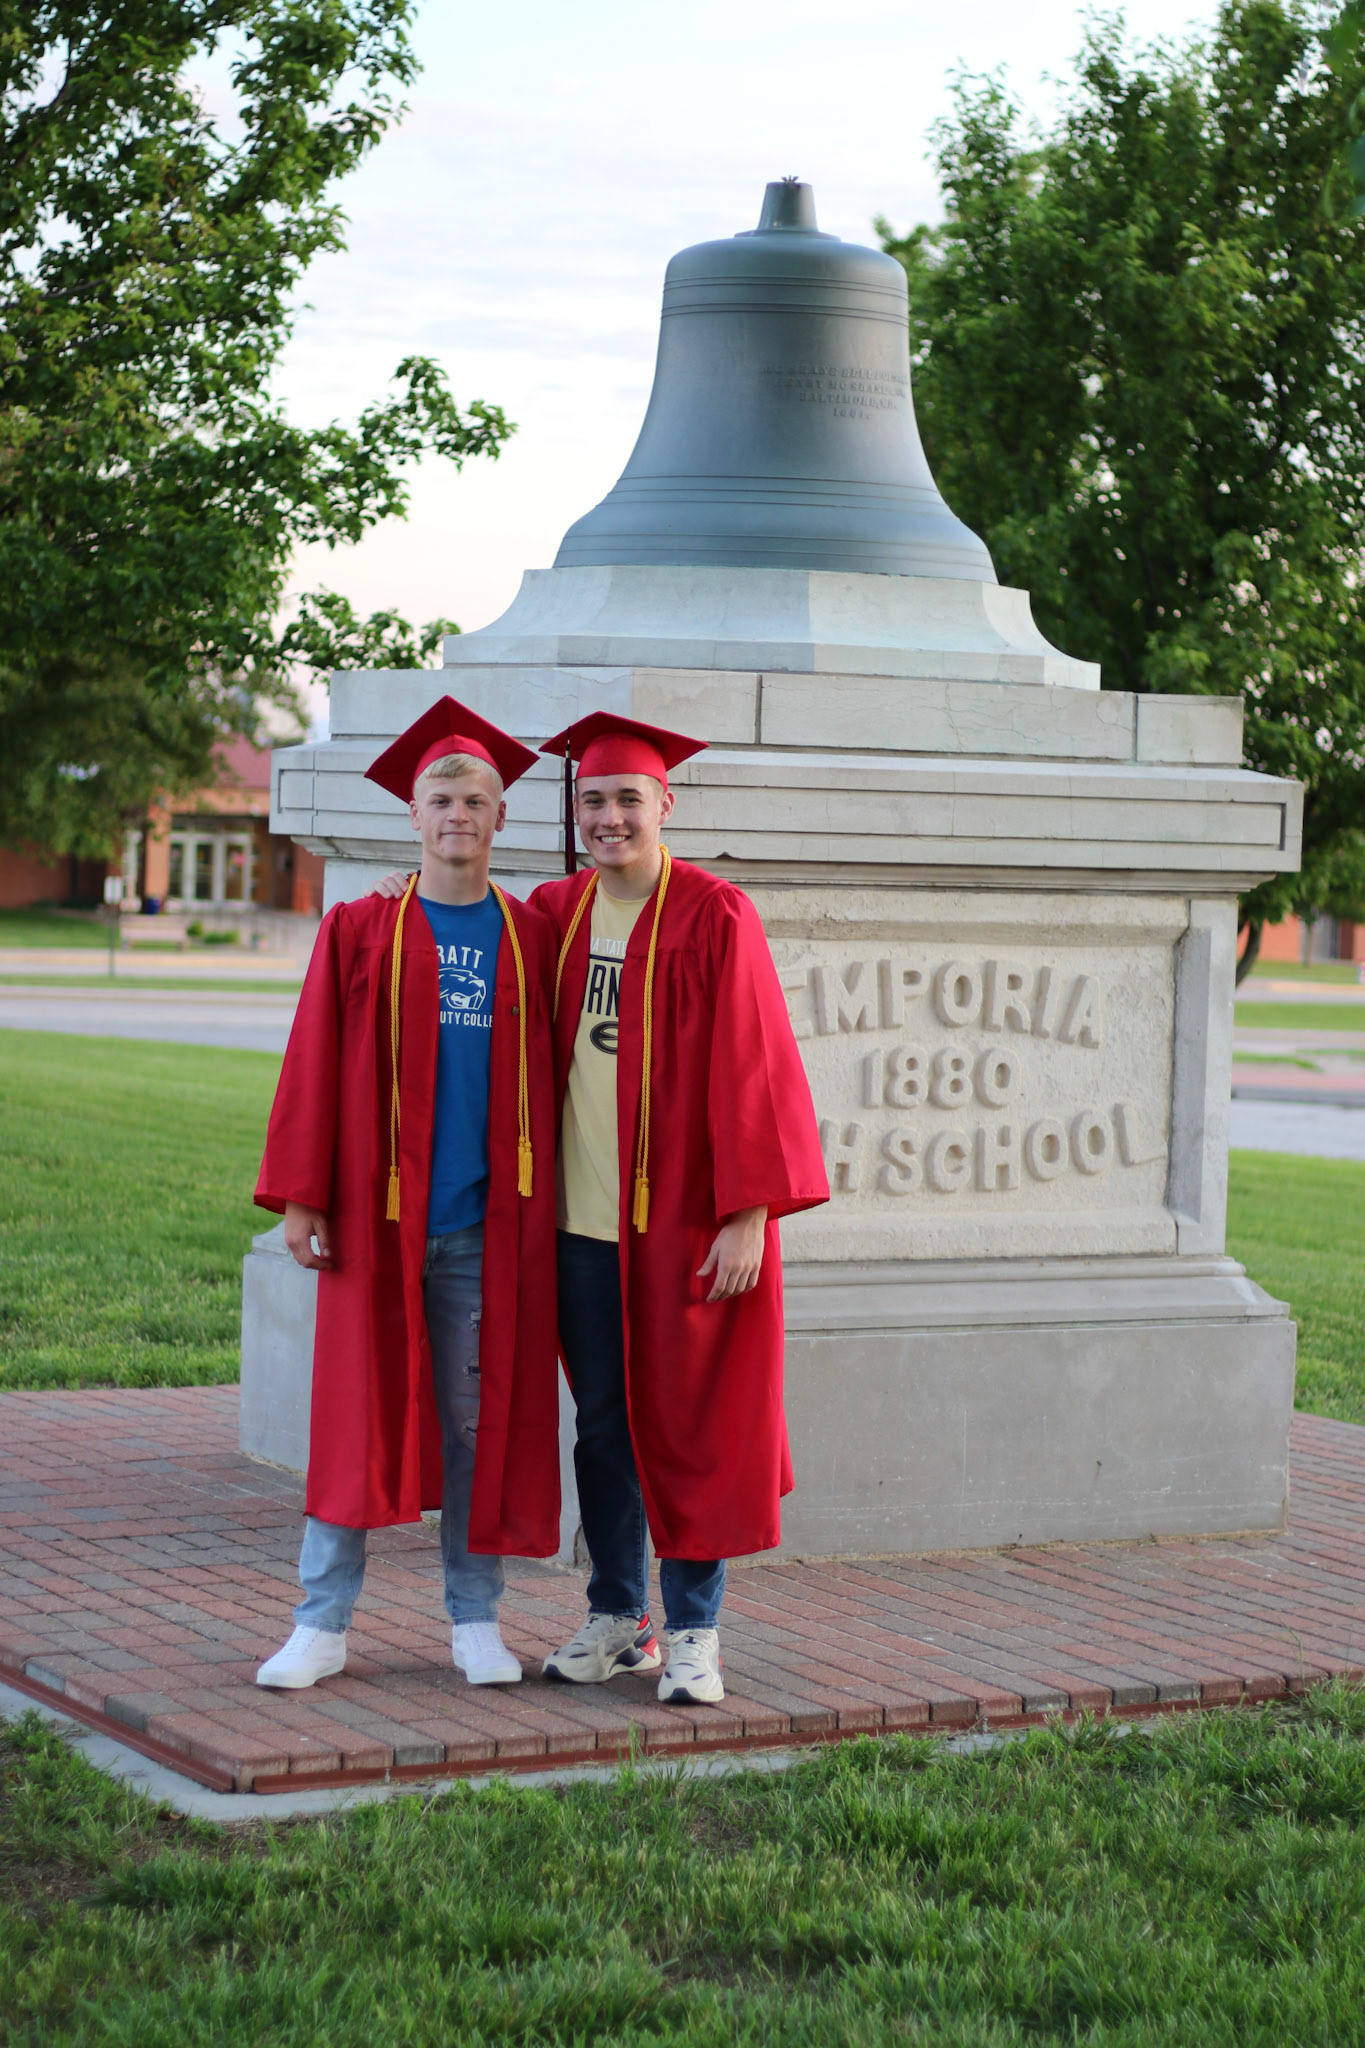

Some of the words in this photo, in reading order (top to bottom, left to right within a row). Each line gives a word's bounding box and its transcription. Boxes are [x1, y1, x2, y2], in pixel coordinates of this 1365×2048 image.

[436, 945, 483, 969] RATT
[863, 1043, 1022, 1110] 1880
[878, 1102, 1167, 1196] SCHOOL
